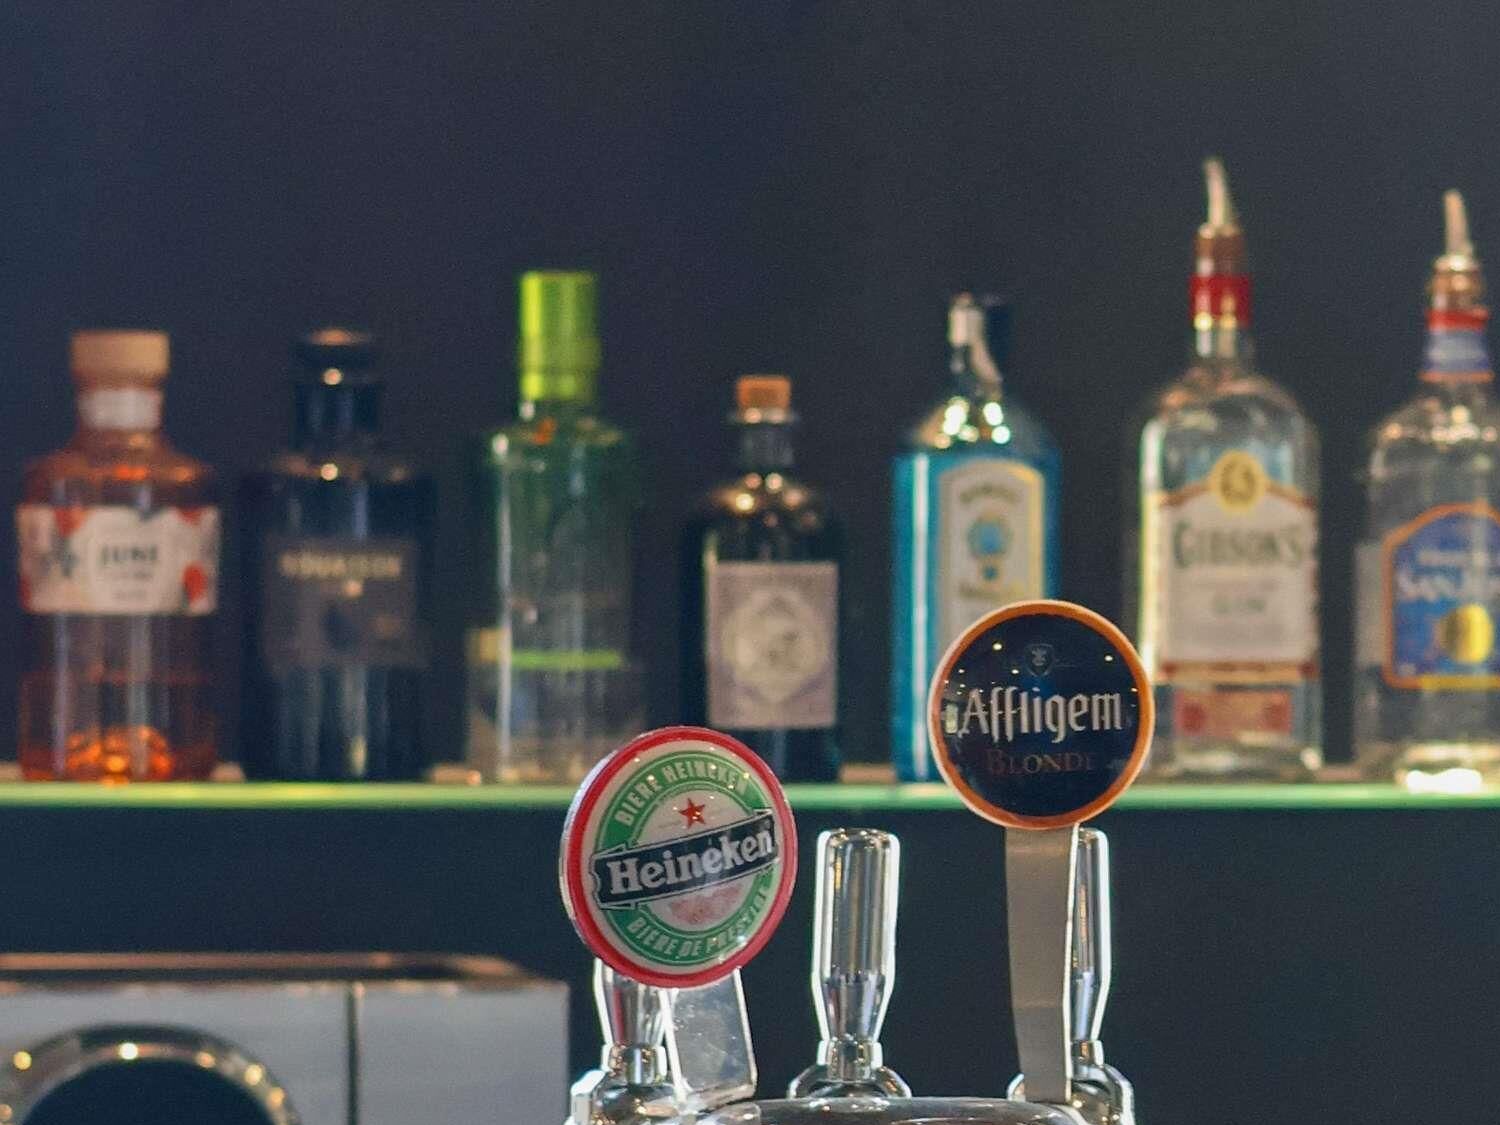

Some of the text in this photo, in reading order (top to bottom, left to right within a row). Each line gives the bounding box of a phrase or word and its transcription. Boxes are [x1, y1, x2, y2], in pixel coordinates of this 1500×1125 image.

[957, 686, 1122, 743] Affligem
[661, 760, 748, 794] HEINEKEN
[606, 829, 774, 895] Heineken
